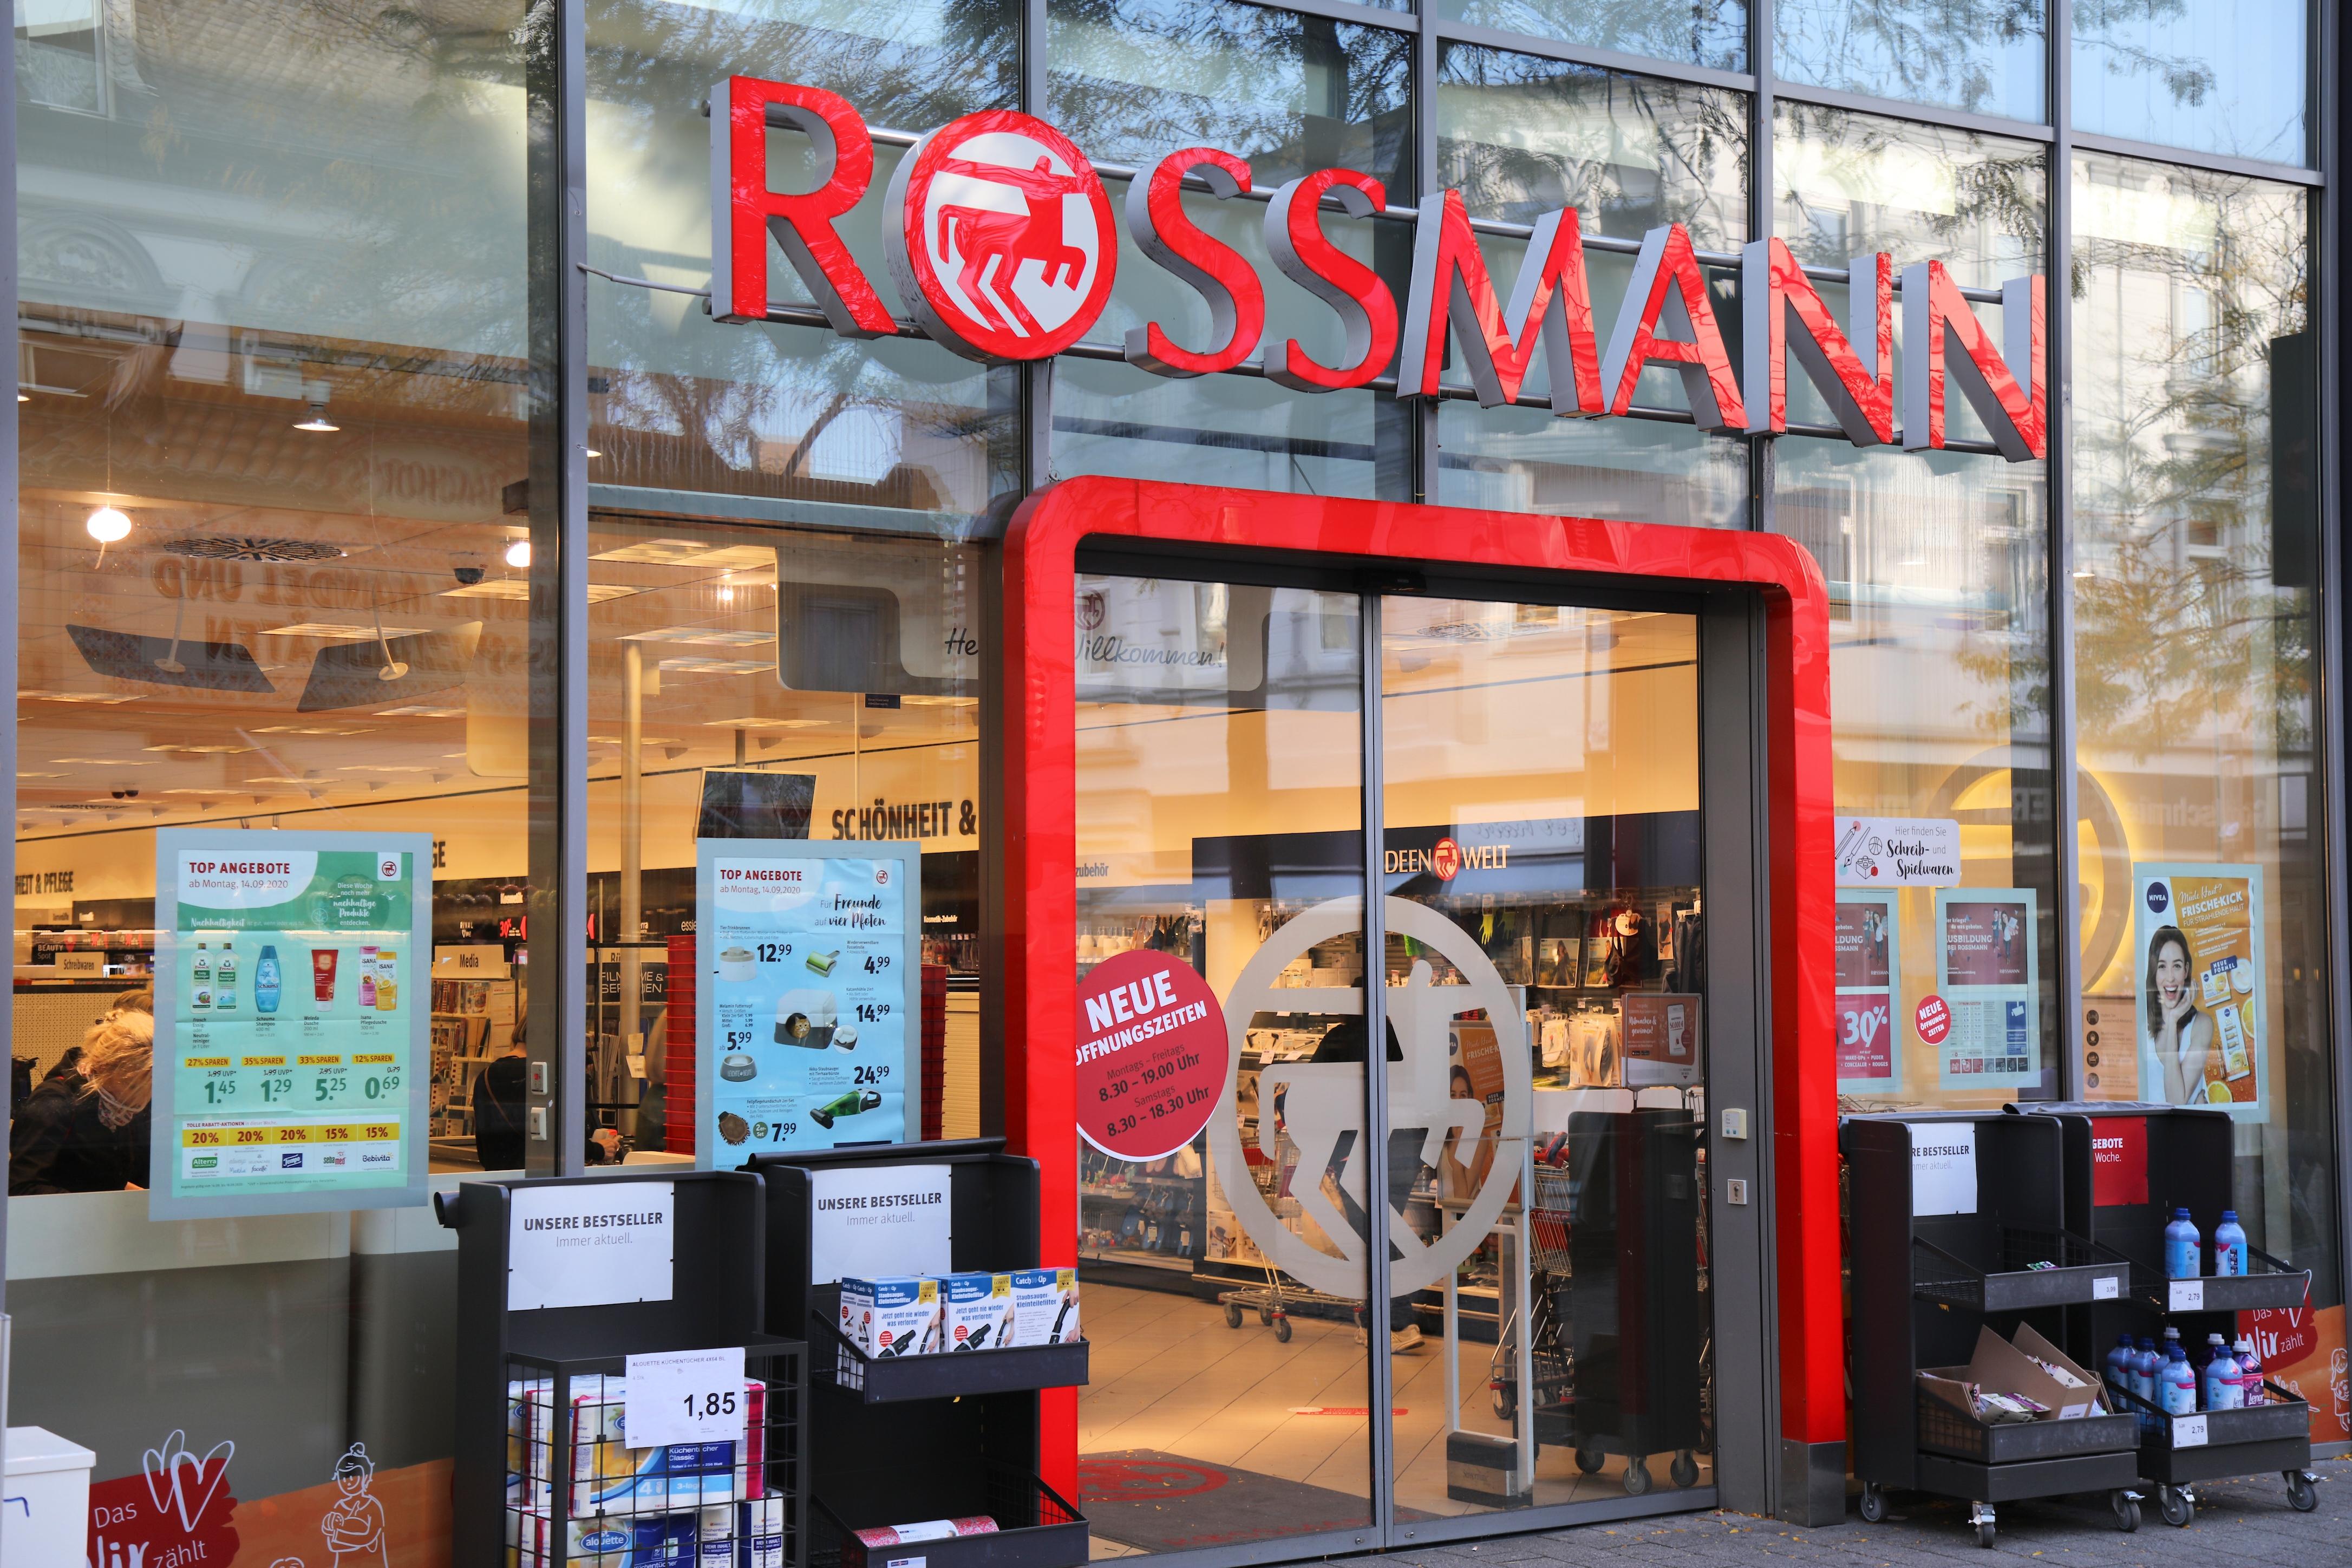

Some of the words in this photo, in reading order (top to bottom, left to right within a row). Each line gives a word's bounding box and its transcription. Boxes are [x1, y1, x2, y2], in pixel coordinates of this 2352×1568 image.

[712, 75, 2046, 463] ROSSMANN
[832, 799, 952, 840] SCHÖNHEIT
[959, 800, 977, 835] &
[1895, 826, 1909, 835] Hier
[1912, 826, 1934, 836] finden
[1936, 827, 1946, 837] Sie
[1886, 839, 1930, 858] Schreib-
[1932, 844, 1946, 854] und
[1461, 845, 1511, 870] WELT
[190, 862, 217, 874] TOP
[220, 862, 290, 874] ANGEBOTE
[1897, 859, 1955, 880] Spielwaren
[44, 871, 74, 893] PFLEGE
[720, 870, 742, 880] TOP
[745, 870, 802, 881] ANGEBOTE
[189, 880, 200, 888] ab
[203, 880, 238, 891] Montag,
[241, 880, 288, 889] 14.09.2020
[720, 885, 729, 893] ab
[731, 886, 760, 895] Montag,
[762, 886, 801, 894] 14.09.2020
[2178, 891, 2200, 905] Müde
[2201, 884, 2222, 899] Haut?
[333, 899, 376, 910] nachhaltige
[820, 899, 832, 909] Für
[834, 893, 883, 912] Freunde
[2181, 891, 2243, 918] FRISCHE-KICK
[339, 907, 369, 919] Produkte
[2183, 918, 2194, 927] FÜR
[2194, 910, 2230, 925] STRAHLENDE
[2230, 903, 2244, 915] HAUT
[192, 917, 245, 929] Nachhaltigkeit
[339, 919, 370, 927] entdecken.
[460, 921, 474, 929] RIVAL
[815, 917, 827, 927] auf
[829, 915, 848, 927] vier
[852, 912, 887, 931] Pfoten
[37, 952, 51, 961] Spot
[460, 953, 479, 968] Media
[757, 944, 792, 963] 12.99
[64, 959, 94, 971] Schreibwaren
[864, 956, 890, 975] 4.99
[2212, 959, 2227, 969] NEUE
[2213, 964, 2235, 975] FORMEL
[1084, 970, 1177, 1034] NEUE
[855, 1004, 890, 1023] 14.99
[1918, 999, 1943, 1021] NEUE
[1628, 1016, 1652, 1025] Mitmachen
[1843, 1005, 1888, 1048] 30%
[1920, 1012, 1947, 1031] ÖFFNUNGS-
[1076, 1000, 1207, 1067] ÖFFNUNGSZEITEN
[1928, 1023, 1945, 1037] ZEITEN
[727, 1031, 752, 1051] 5.99
[187, 1058, 204, 1066] 27%
[205, 1057, 228, 1066] SPAREN
[244, 1057, 259, 1066] 35%
[260, 1056, 283, 1064] SPAREN
[299, 1056, 315, 1064] 33%
[316, 1055, 339, 1064] SPAREN
[370, 1054, 393, 1062] SPAREN
[1107, 1060, 1144, 1080] Montags
[1152, 1043, 1185, 1063] Freitags
[854, 1066, 890, 1084] 24.99
[1099, 1080, 1128, 1102] 8.30
[1141, 1061, 1174, 1086] 19.00
[1179, 1053, 1200, 1071] Uhr
[204, 1080, 236, 1103] 1.45
[260, 1079, 292, 1102] 1.29
[315, 1077, 347, 1101] 5.25
[364, 1076, 400, 1100] 0.69
[1134, 1084, 1176, 1108] Samstags
[1107, 1114, 1136, 1137] 8.30
[1149, 1096, 1184, 1120] 18.30
[1187, 1086, 1210, 1106] Uhr
[192, 1133, 219, 1144] 20%
[237, 1131, 264, 1142] 20%
[280, 1129, 306, 1140] 20%
[325, 1128, 348, 1139] 15%
[365, 1127, 388, 1138] 15%
[771, 1123, 796, 1143] 7.99
[2092, 1138, 2124, 1149] GEBOTE
[363, 1154, 390, 1162] Bebivita
[1923, 1145, 1969, 1157] BESTSELLER
[2095, 1152, 2121, 1163] Woche.
[283, 1155, 301, 1167] Tempo
[1930, 1160, 1952, 1170] aktuell.
[818, 1196, 867, 1211] UNSERE
[871, 1192, 942, 1208] BESTSELLER
[524, 1216, 579, 1231] UNSERE
[583, 1211, 663, 1228] BESTSELLER
[846, 1213, 881, 1226] Immer
[884, 1211, 916, 1225] aktuell.
[556, 1233, 591, 1247] Immer
[594, 1231, 633, 1245] aktuell.
[1016, 1276, 1031, 1285] Catch
[1038, 1275, 1047, 1285] Up
[1016, 1293, 1050, 1301] Staubsauger-
[1016, 1299, 1056, 1309] Kleinteilefilter
[2188, 1292, 2200, 1302] 2,79
[894, 1312, 905, 1320] geht
[968, 1306, 979, 1315] geht
[2253, 1308, 2272, 1322] Das
[2280, 1333, 2305, 1353] zählt
[662, 1357, 704, 1365] KÜCHENTÜCHER
[684, 1391, 735, 1421] 1,85
[2191, 1426, 2204, 1435] 2,79
[639, 1484, 652, 1494] 4
[94, 1503, 138, 1528] Das
[153, 1538, 208, 1568] zählt
